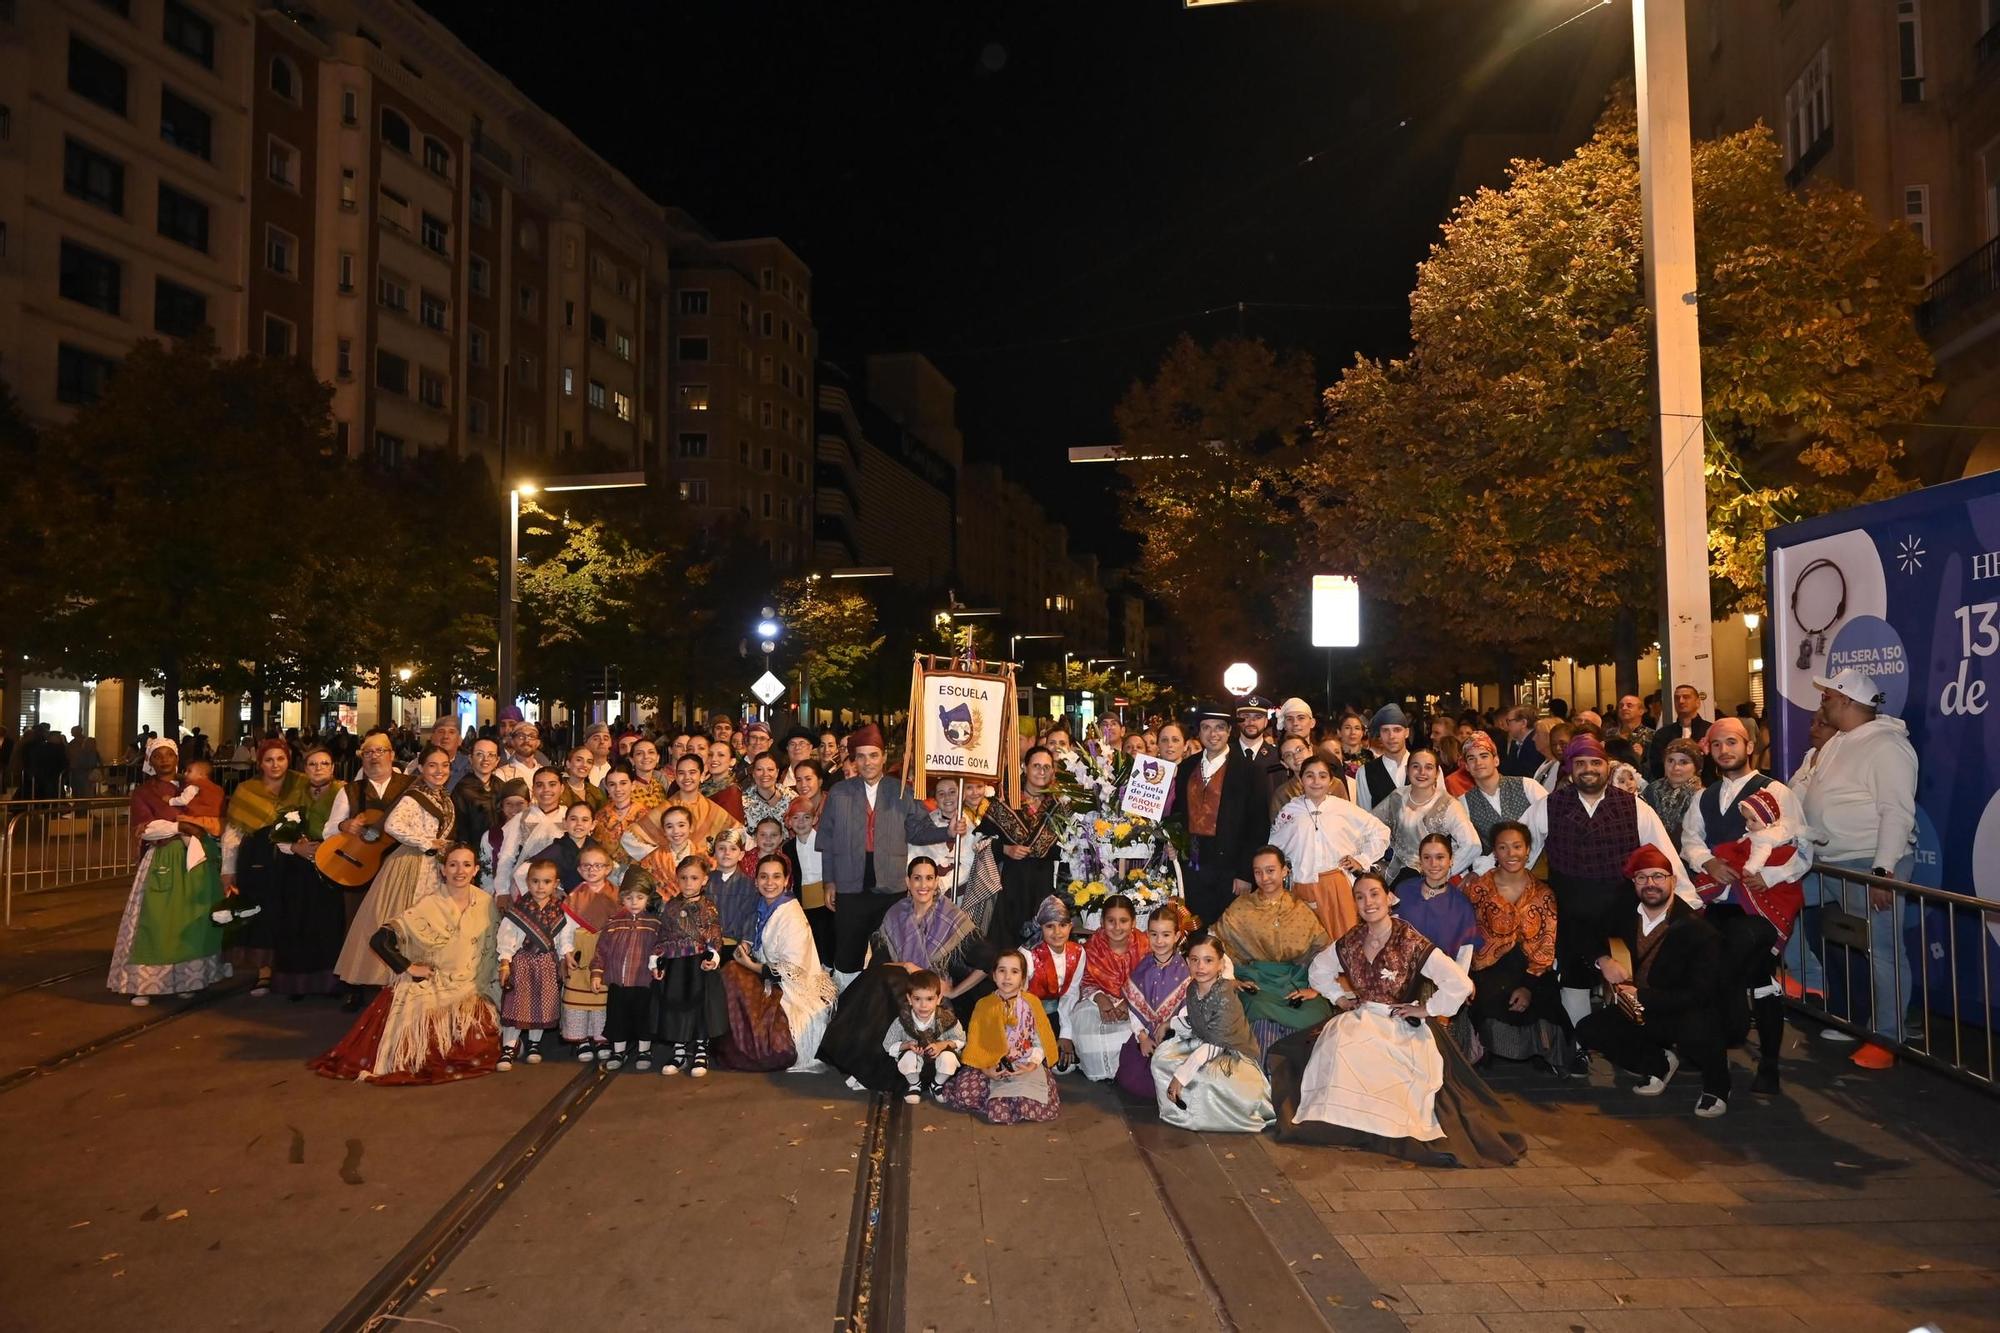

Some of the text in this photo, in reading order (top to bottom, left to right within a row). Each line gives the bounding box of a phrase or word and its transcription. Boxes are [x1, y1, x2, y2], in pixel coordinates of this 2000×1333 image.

[1954, 602, 2000, 657] 13
[1831, 645, 1902, 664] PULSERA 150
[939, 685, 988, 700] ESCUELA
[1940, 659, 1989, 716] de
[926, 754, 989, 769] PARQUE GOYA
[1131, 780, 1164, 794] Escuela
[1128, 795, 1161, 809] PARQUE
[1142, 790, 1161, 801] jota
[1131, 803, 1154, 814] GOYA
